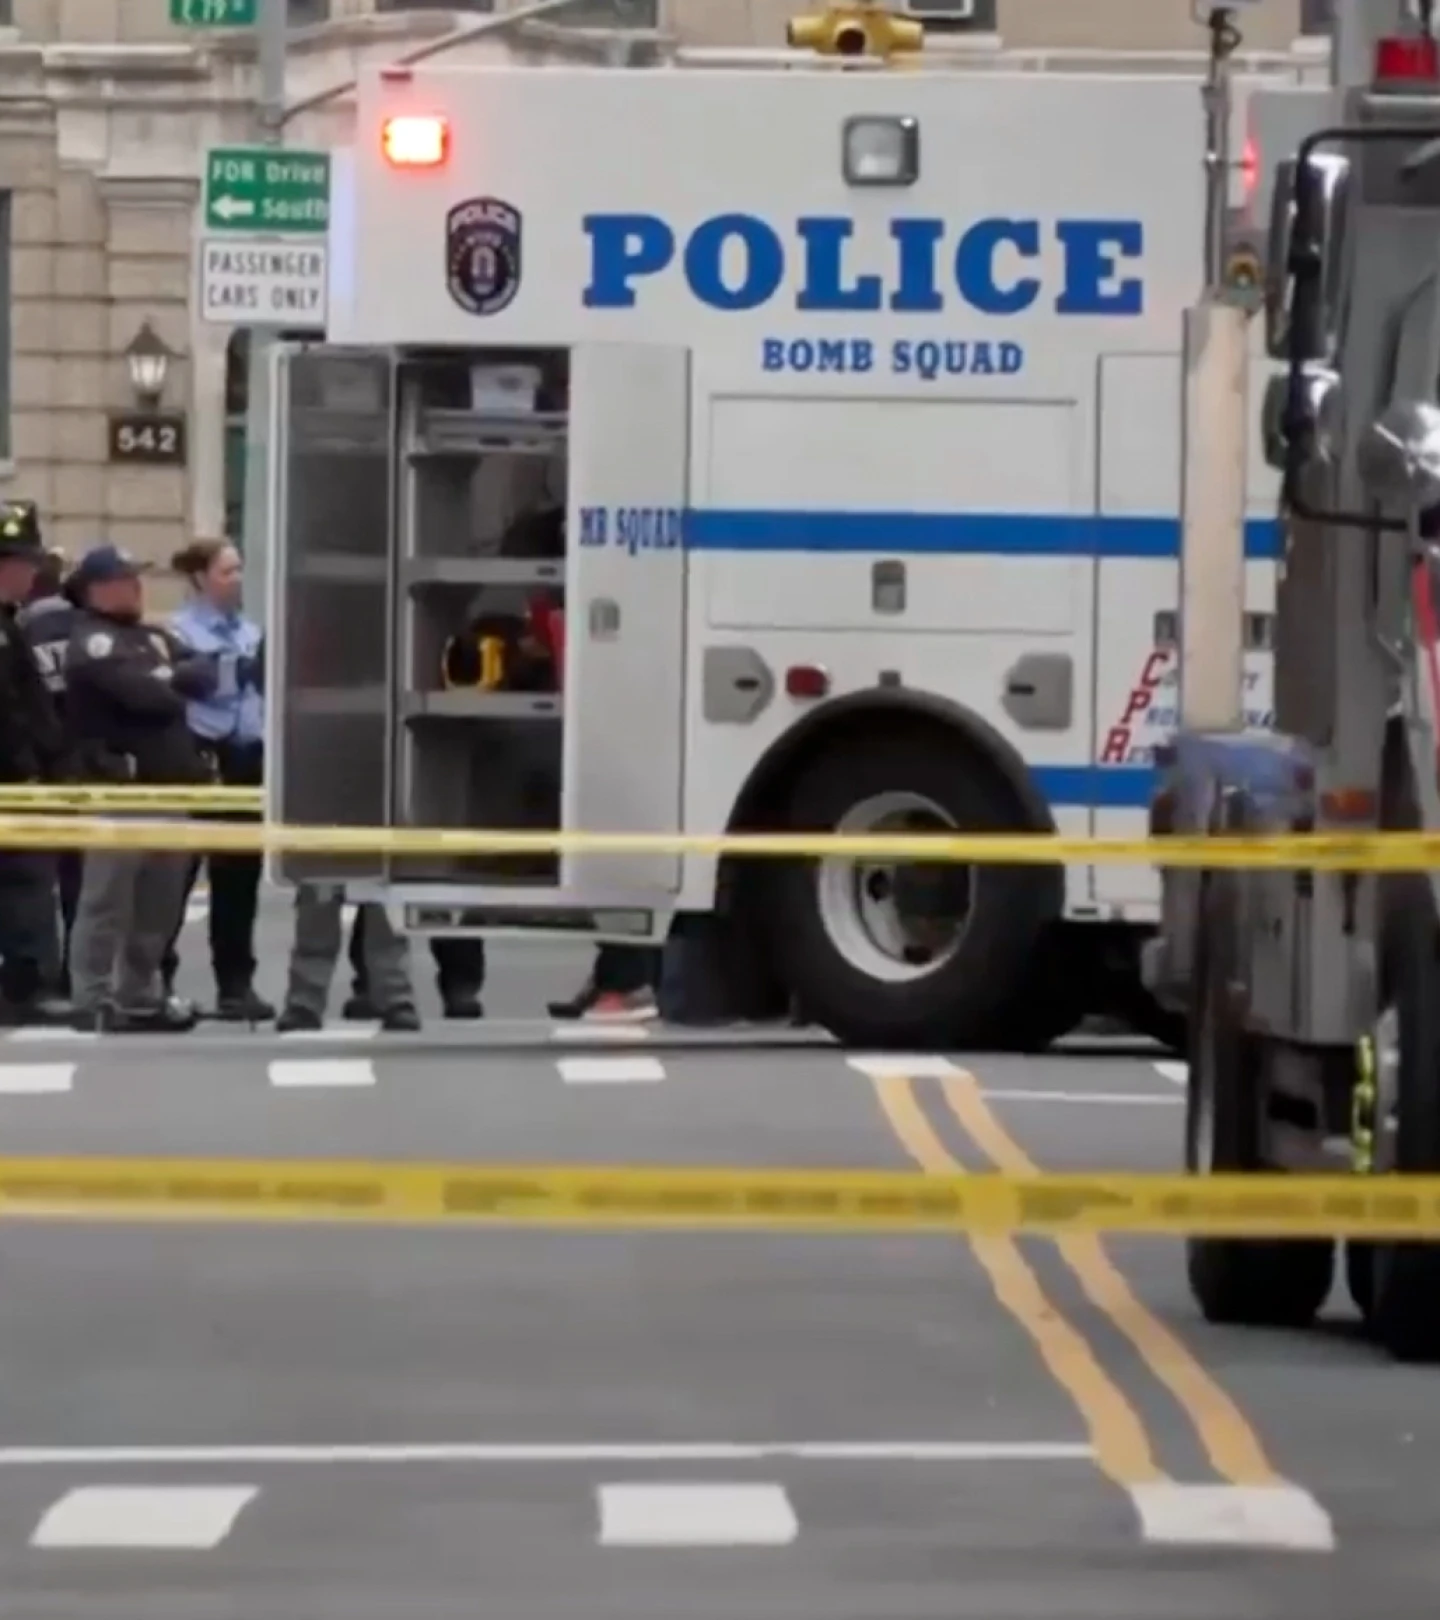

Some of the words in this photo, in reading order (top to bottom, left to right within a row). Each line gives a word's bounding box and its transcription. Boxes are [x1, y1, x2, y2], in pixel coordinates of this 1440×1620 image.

[212, 160, 255, 183] FDR
[265, 160, 325, 184] Drive
[262, 197, 328, 221] South
[208, 251, 321, 277] PASSENGER
[582, 213, 1143, 315] POLICE
[208, 284, 258, 308] CARS
[271, 285, 319, 310] ONLY
[762, 337, 873, 373] BOMB
[891, 339, 1024, 381] SQUAD
[118, 425, 176, 453] 542
